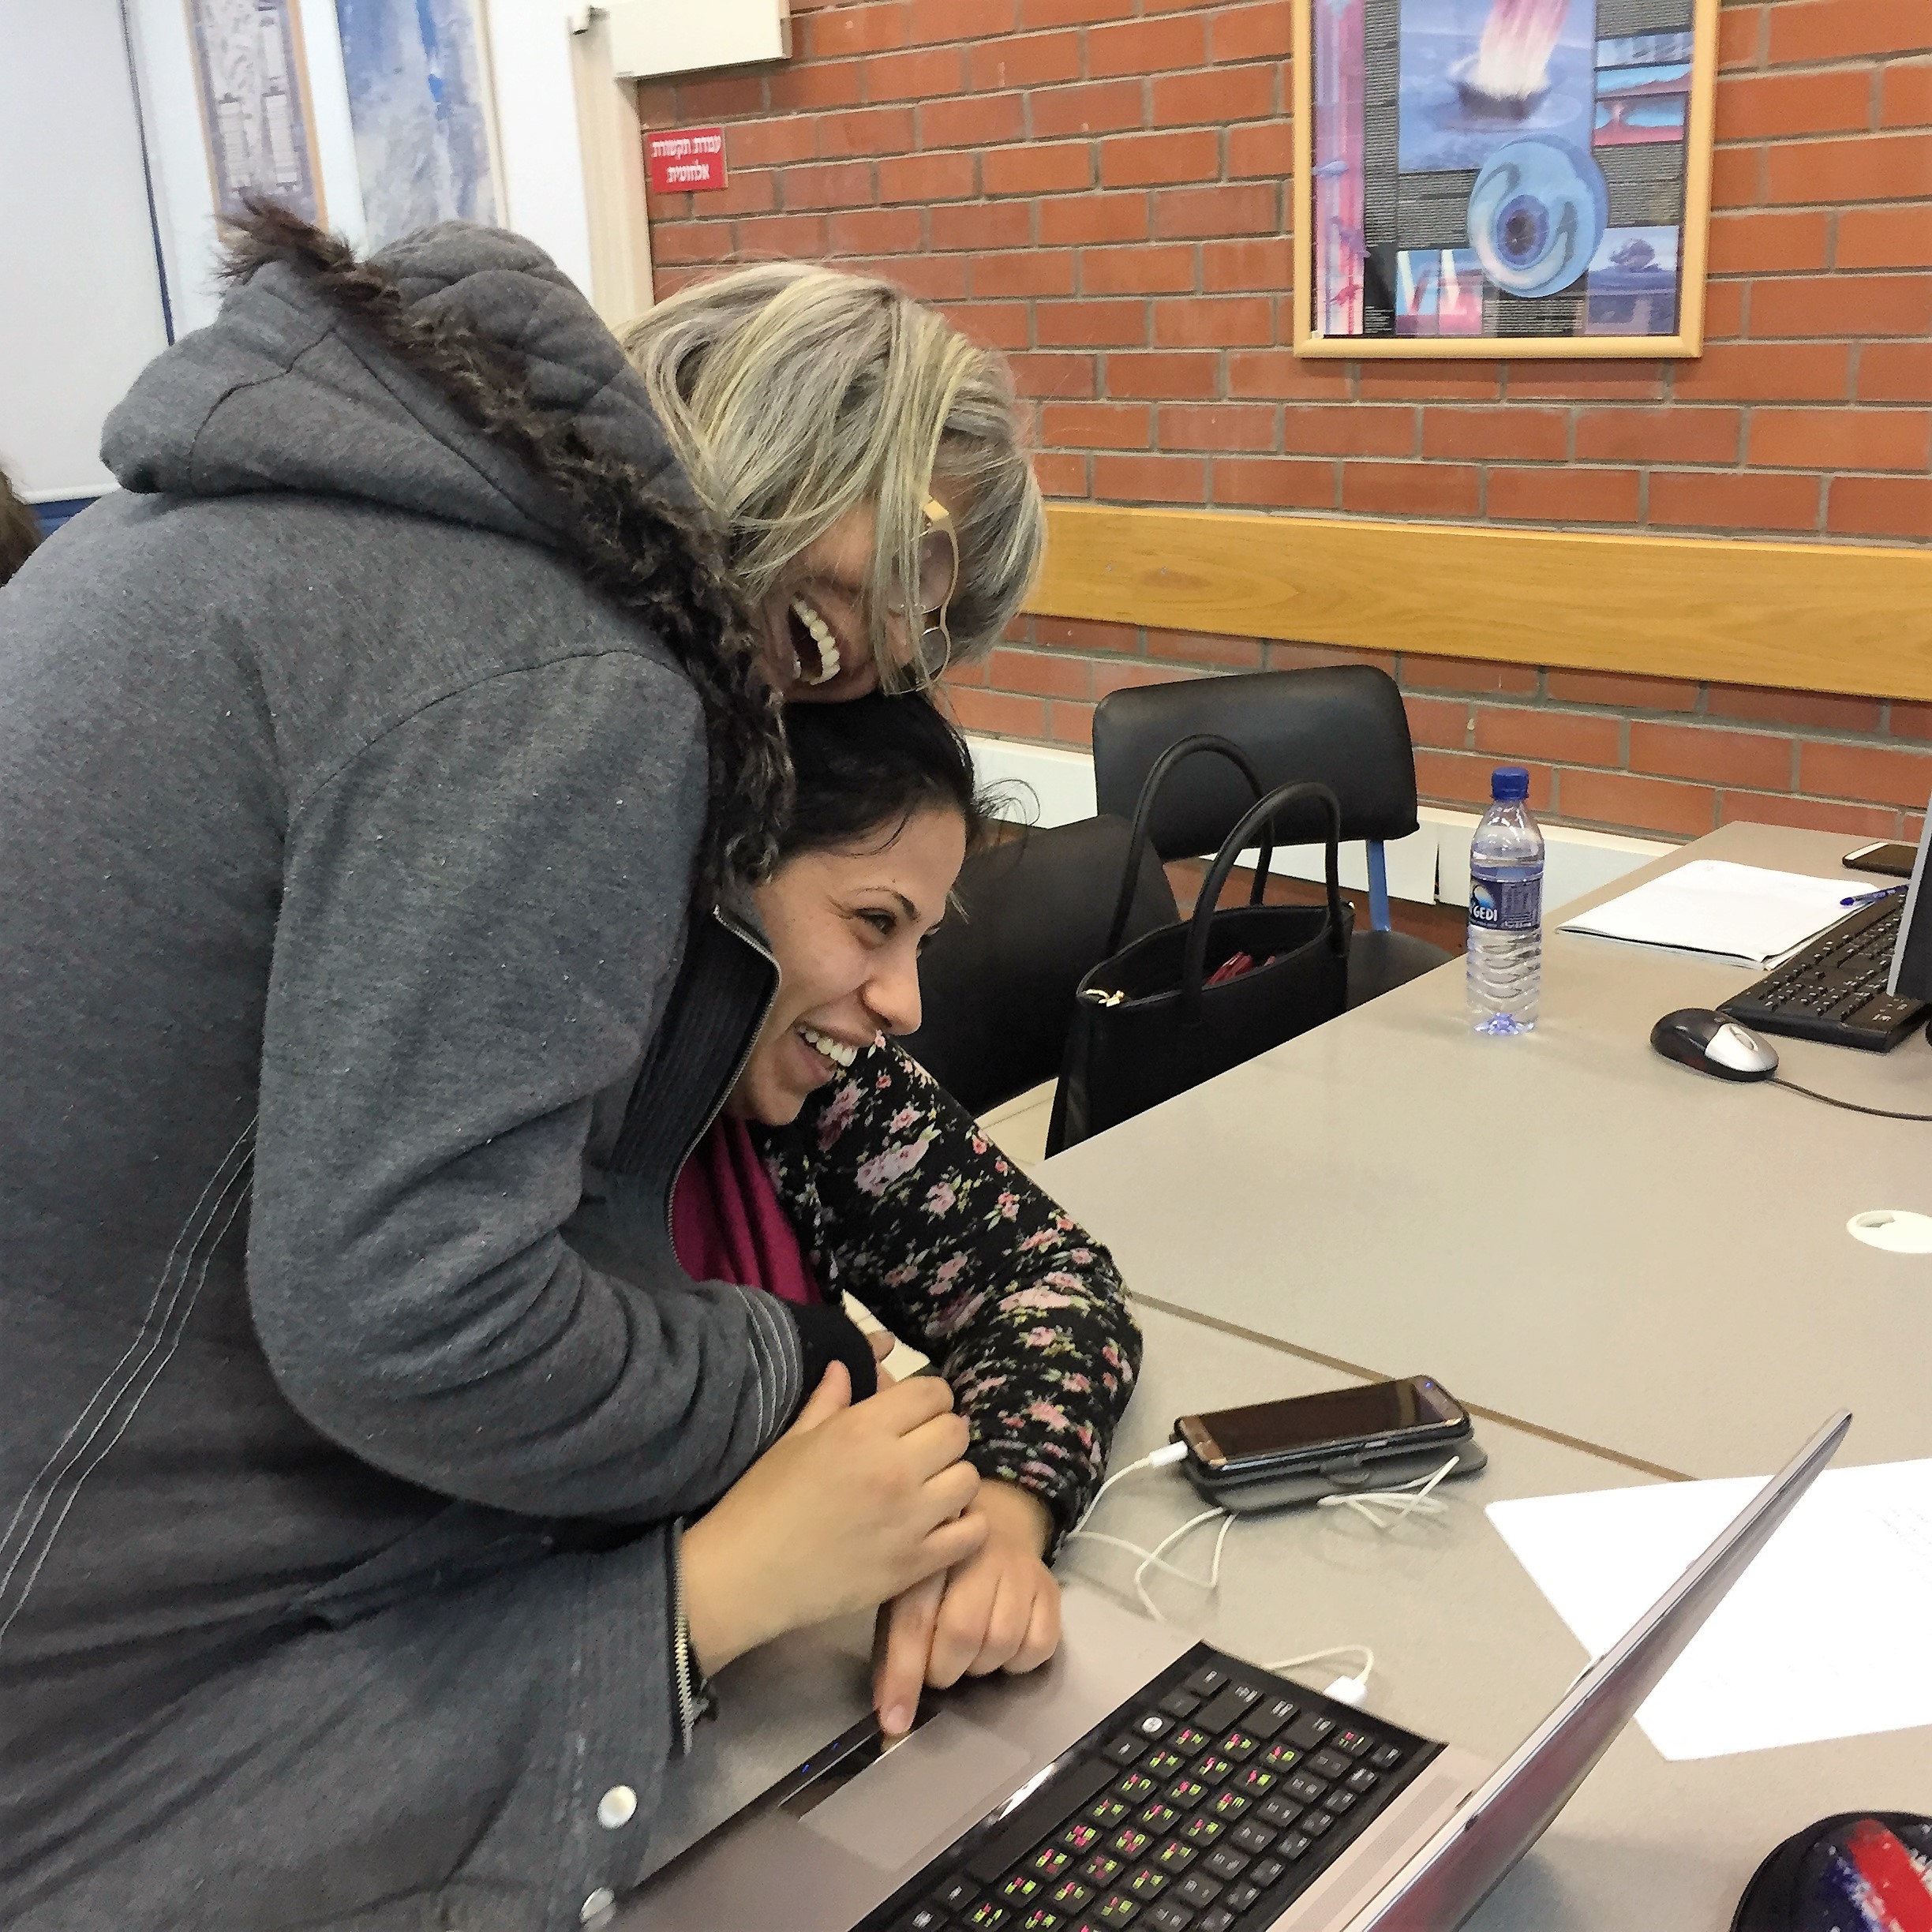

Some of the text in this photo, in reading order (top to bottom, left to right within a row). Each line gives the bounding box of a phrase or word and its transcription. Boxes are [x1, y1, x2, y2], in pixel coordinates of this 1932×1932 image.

[651, 139, 691, 159] תקשורת
[666, 159, 710, 183] אלחוטית
[1473, 906, 1498, 922] GEDI
